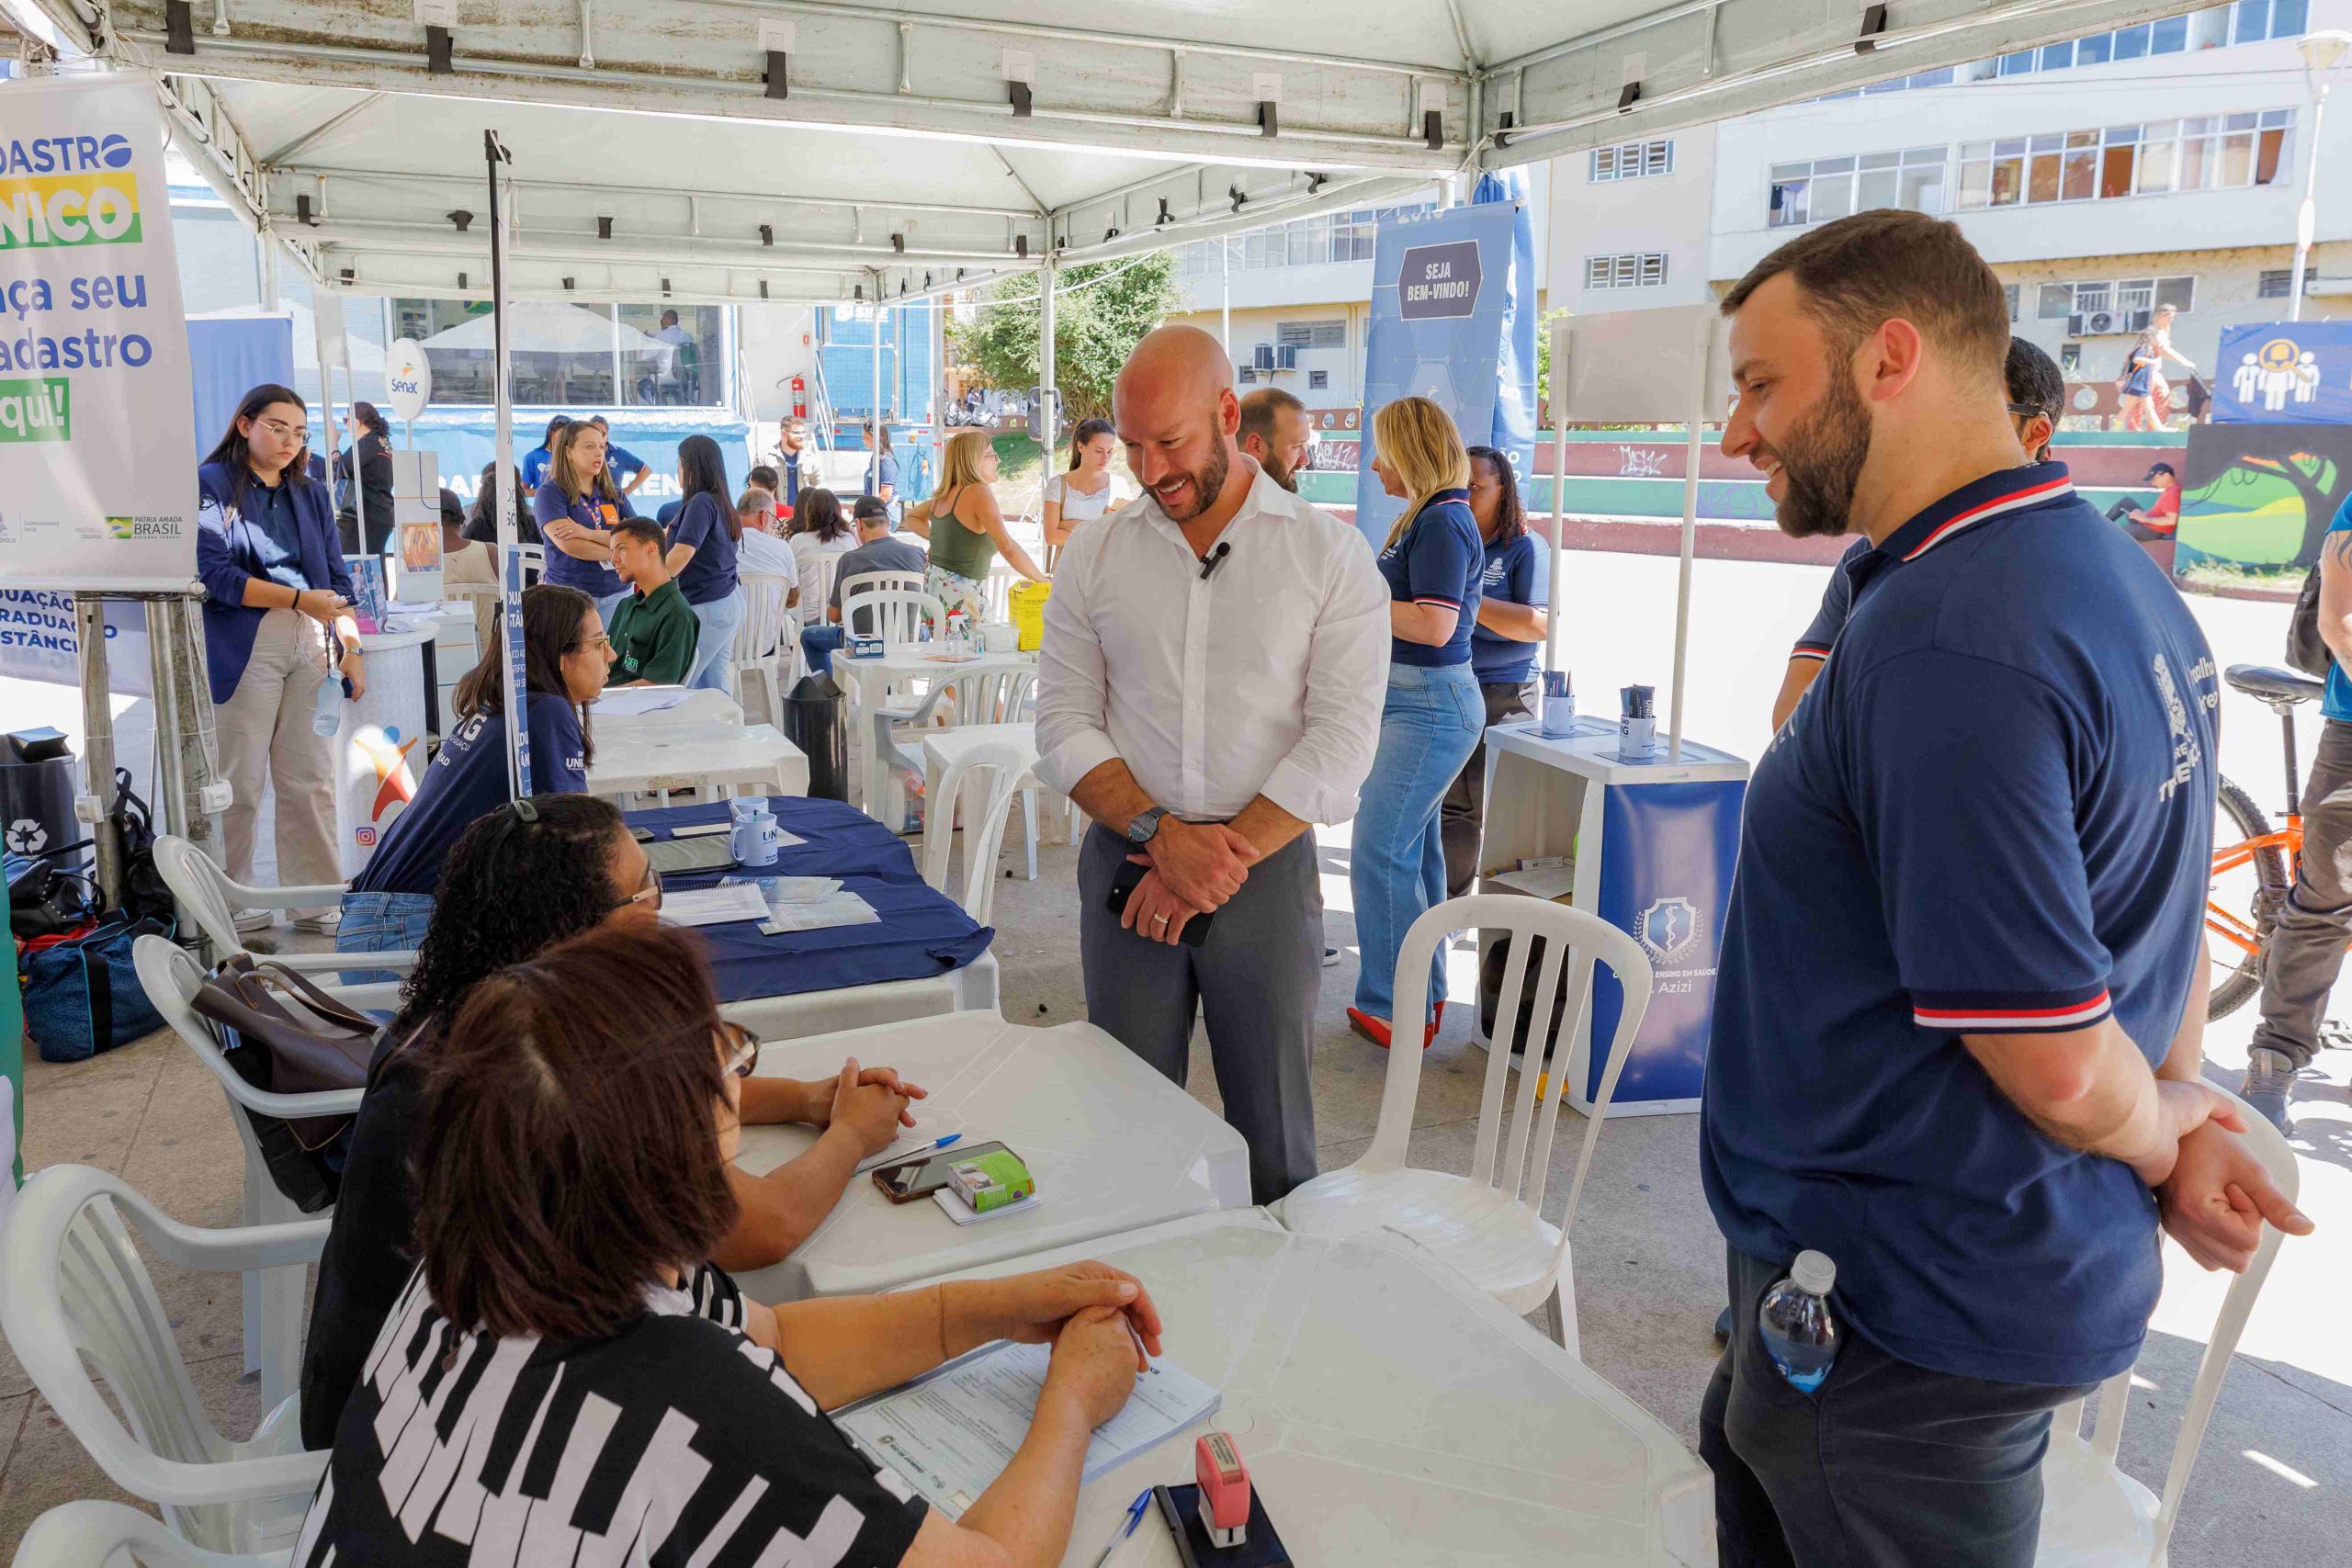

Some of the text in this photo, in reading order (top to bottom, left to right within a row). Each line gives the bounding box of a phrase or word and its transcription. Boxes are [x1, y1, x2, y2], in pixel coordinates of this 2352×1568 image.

[1425, 262, 1451, 280] SEJA
[70, 276, 147, 310] seu
[1407, 281, 1469, 301] BEM-VINDO!
[391, 378, 417, 394] Senac
[134, 523, 182, 535] BRASIL
[1, 630, 78, 654] STÂNCI
[1655, 970, 1681, 978] ENSINO
[1693, 967, 1716, 976] SAÚDE
[1658, 980, 1691, 994] Azizi
